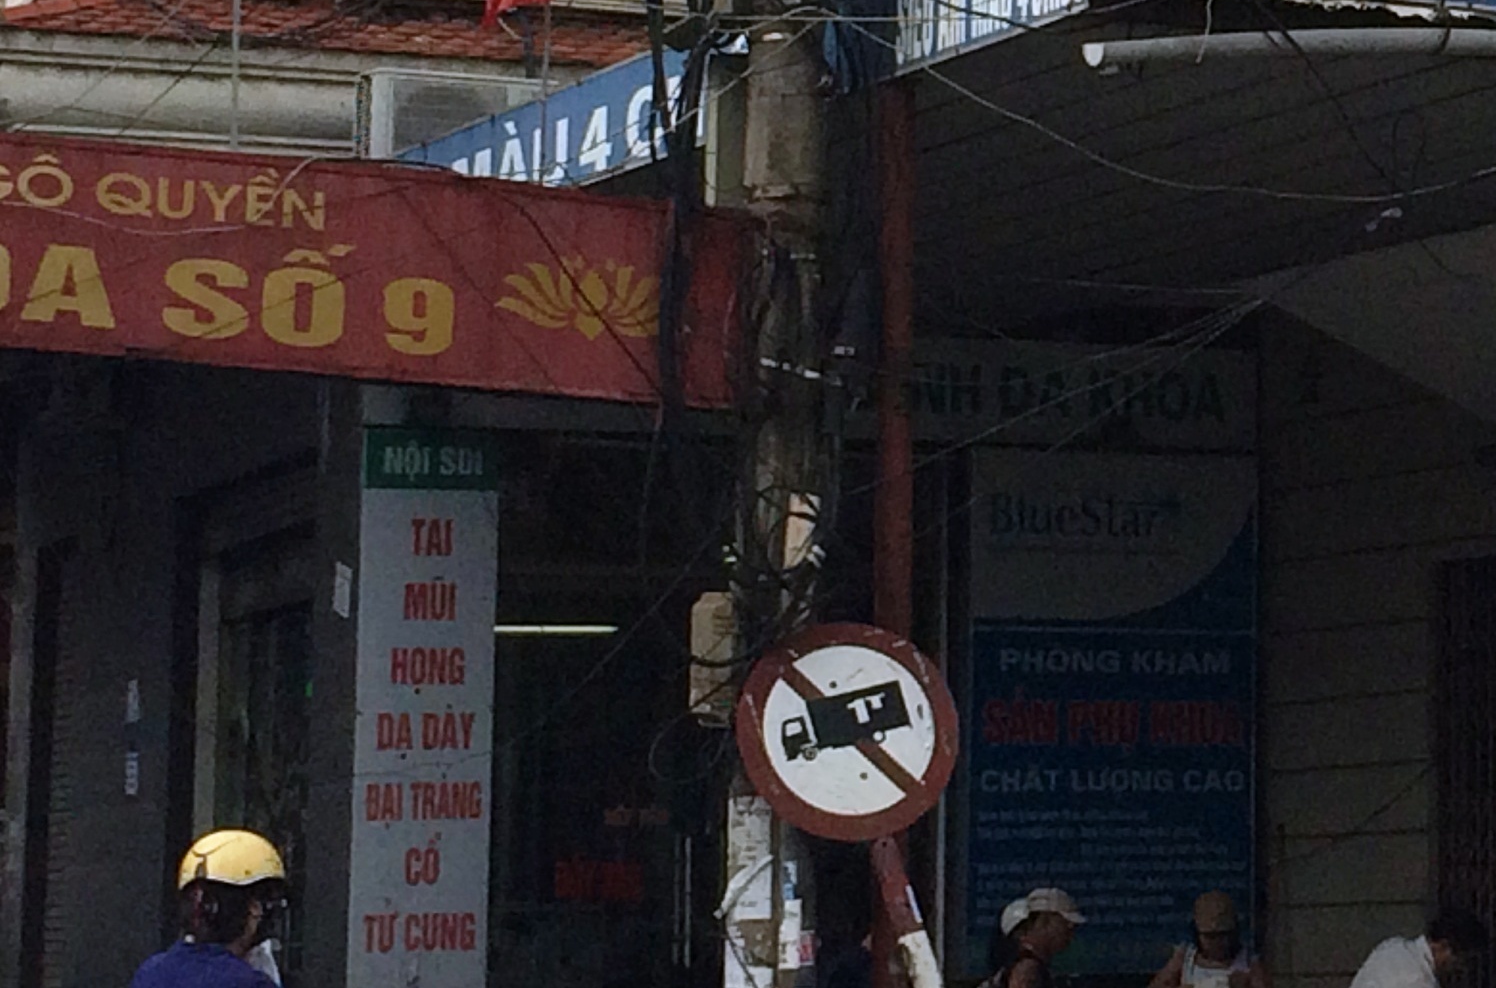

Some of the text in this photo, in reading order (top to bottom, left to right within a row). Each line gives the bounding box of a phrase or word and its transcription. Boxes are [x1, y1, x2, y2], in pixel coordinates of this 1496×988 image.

[578, 105, 614, 173] 4
[96, 166, 327, 233] QUYỀN
[161, 243, 358, 350] SỐ
[384, 276, 456, 356] 9
[412, 517, 455, 557] TAI
[389, 646, 466, 694] HỌNG
[376, 703, 476, 761] DẠ DÀY
[403, 913, 477, 952] CUNG
